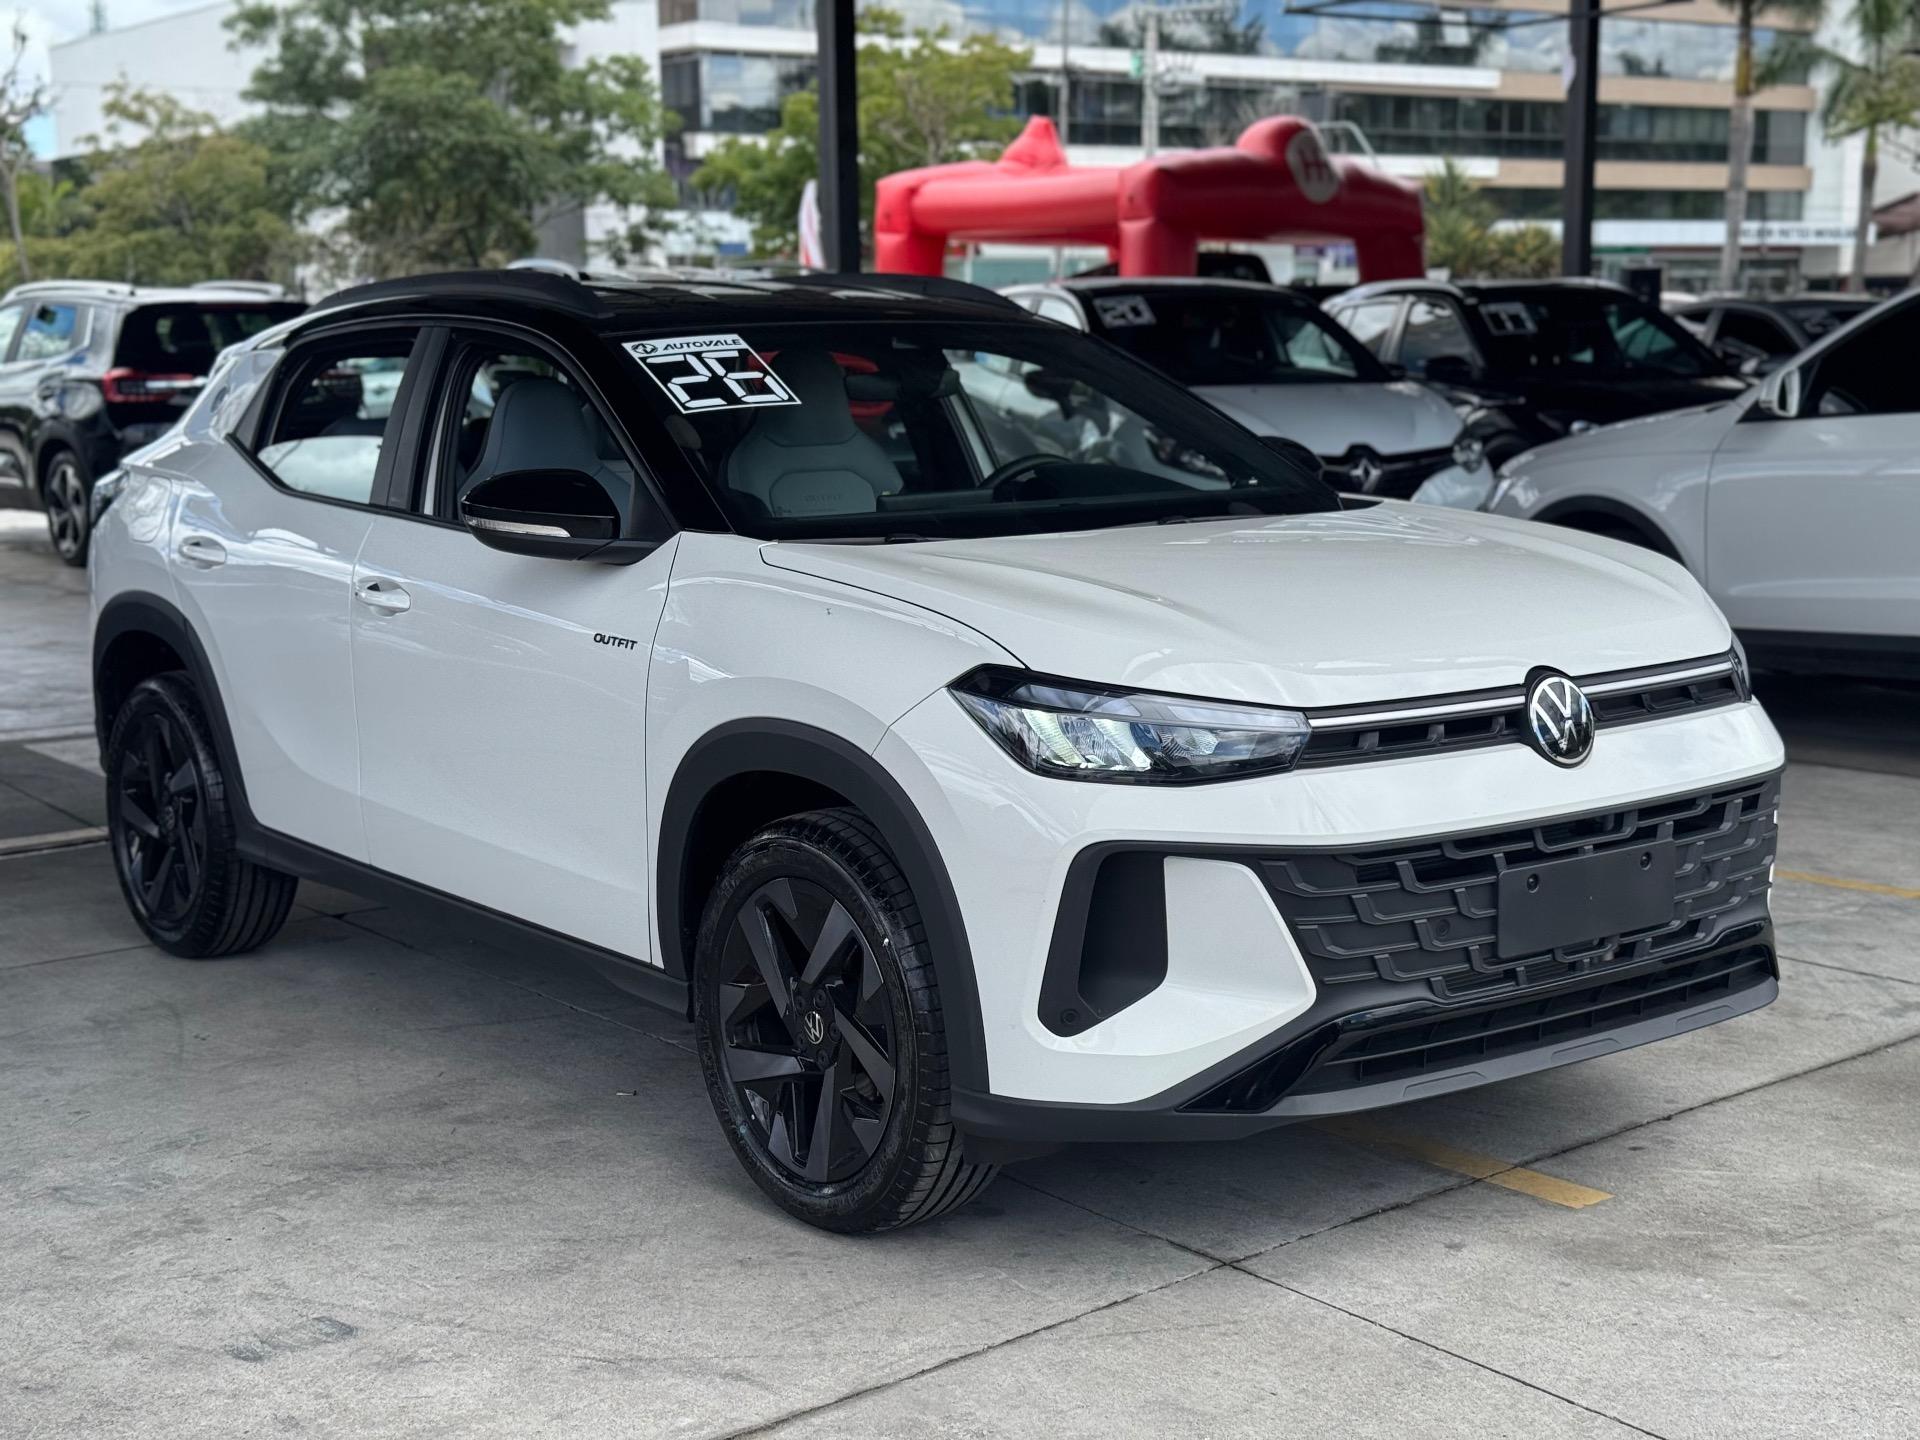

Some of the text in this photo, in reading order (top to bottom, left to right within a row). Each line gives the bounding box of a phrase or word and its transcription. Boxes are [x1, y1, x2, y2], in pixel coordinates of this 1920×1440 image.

[663, 339, 743, 351] AUTOVALE
[646, 350, 789, 408] 26
[593, 633, 638, 650] OUTFIT
